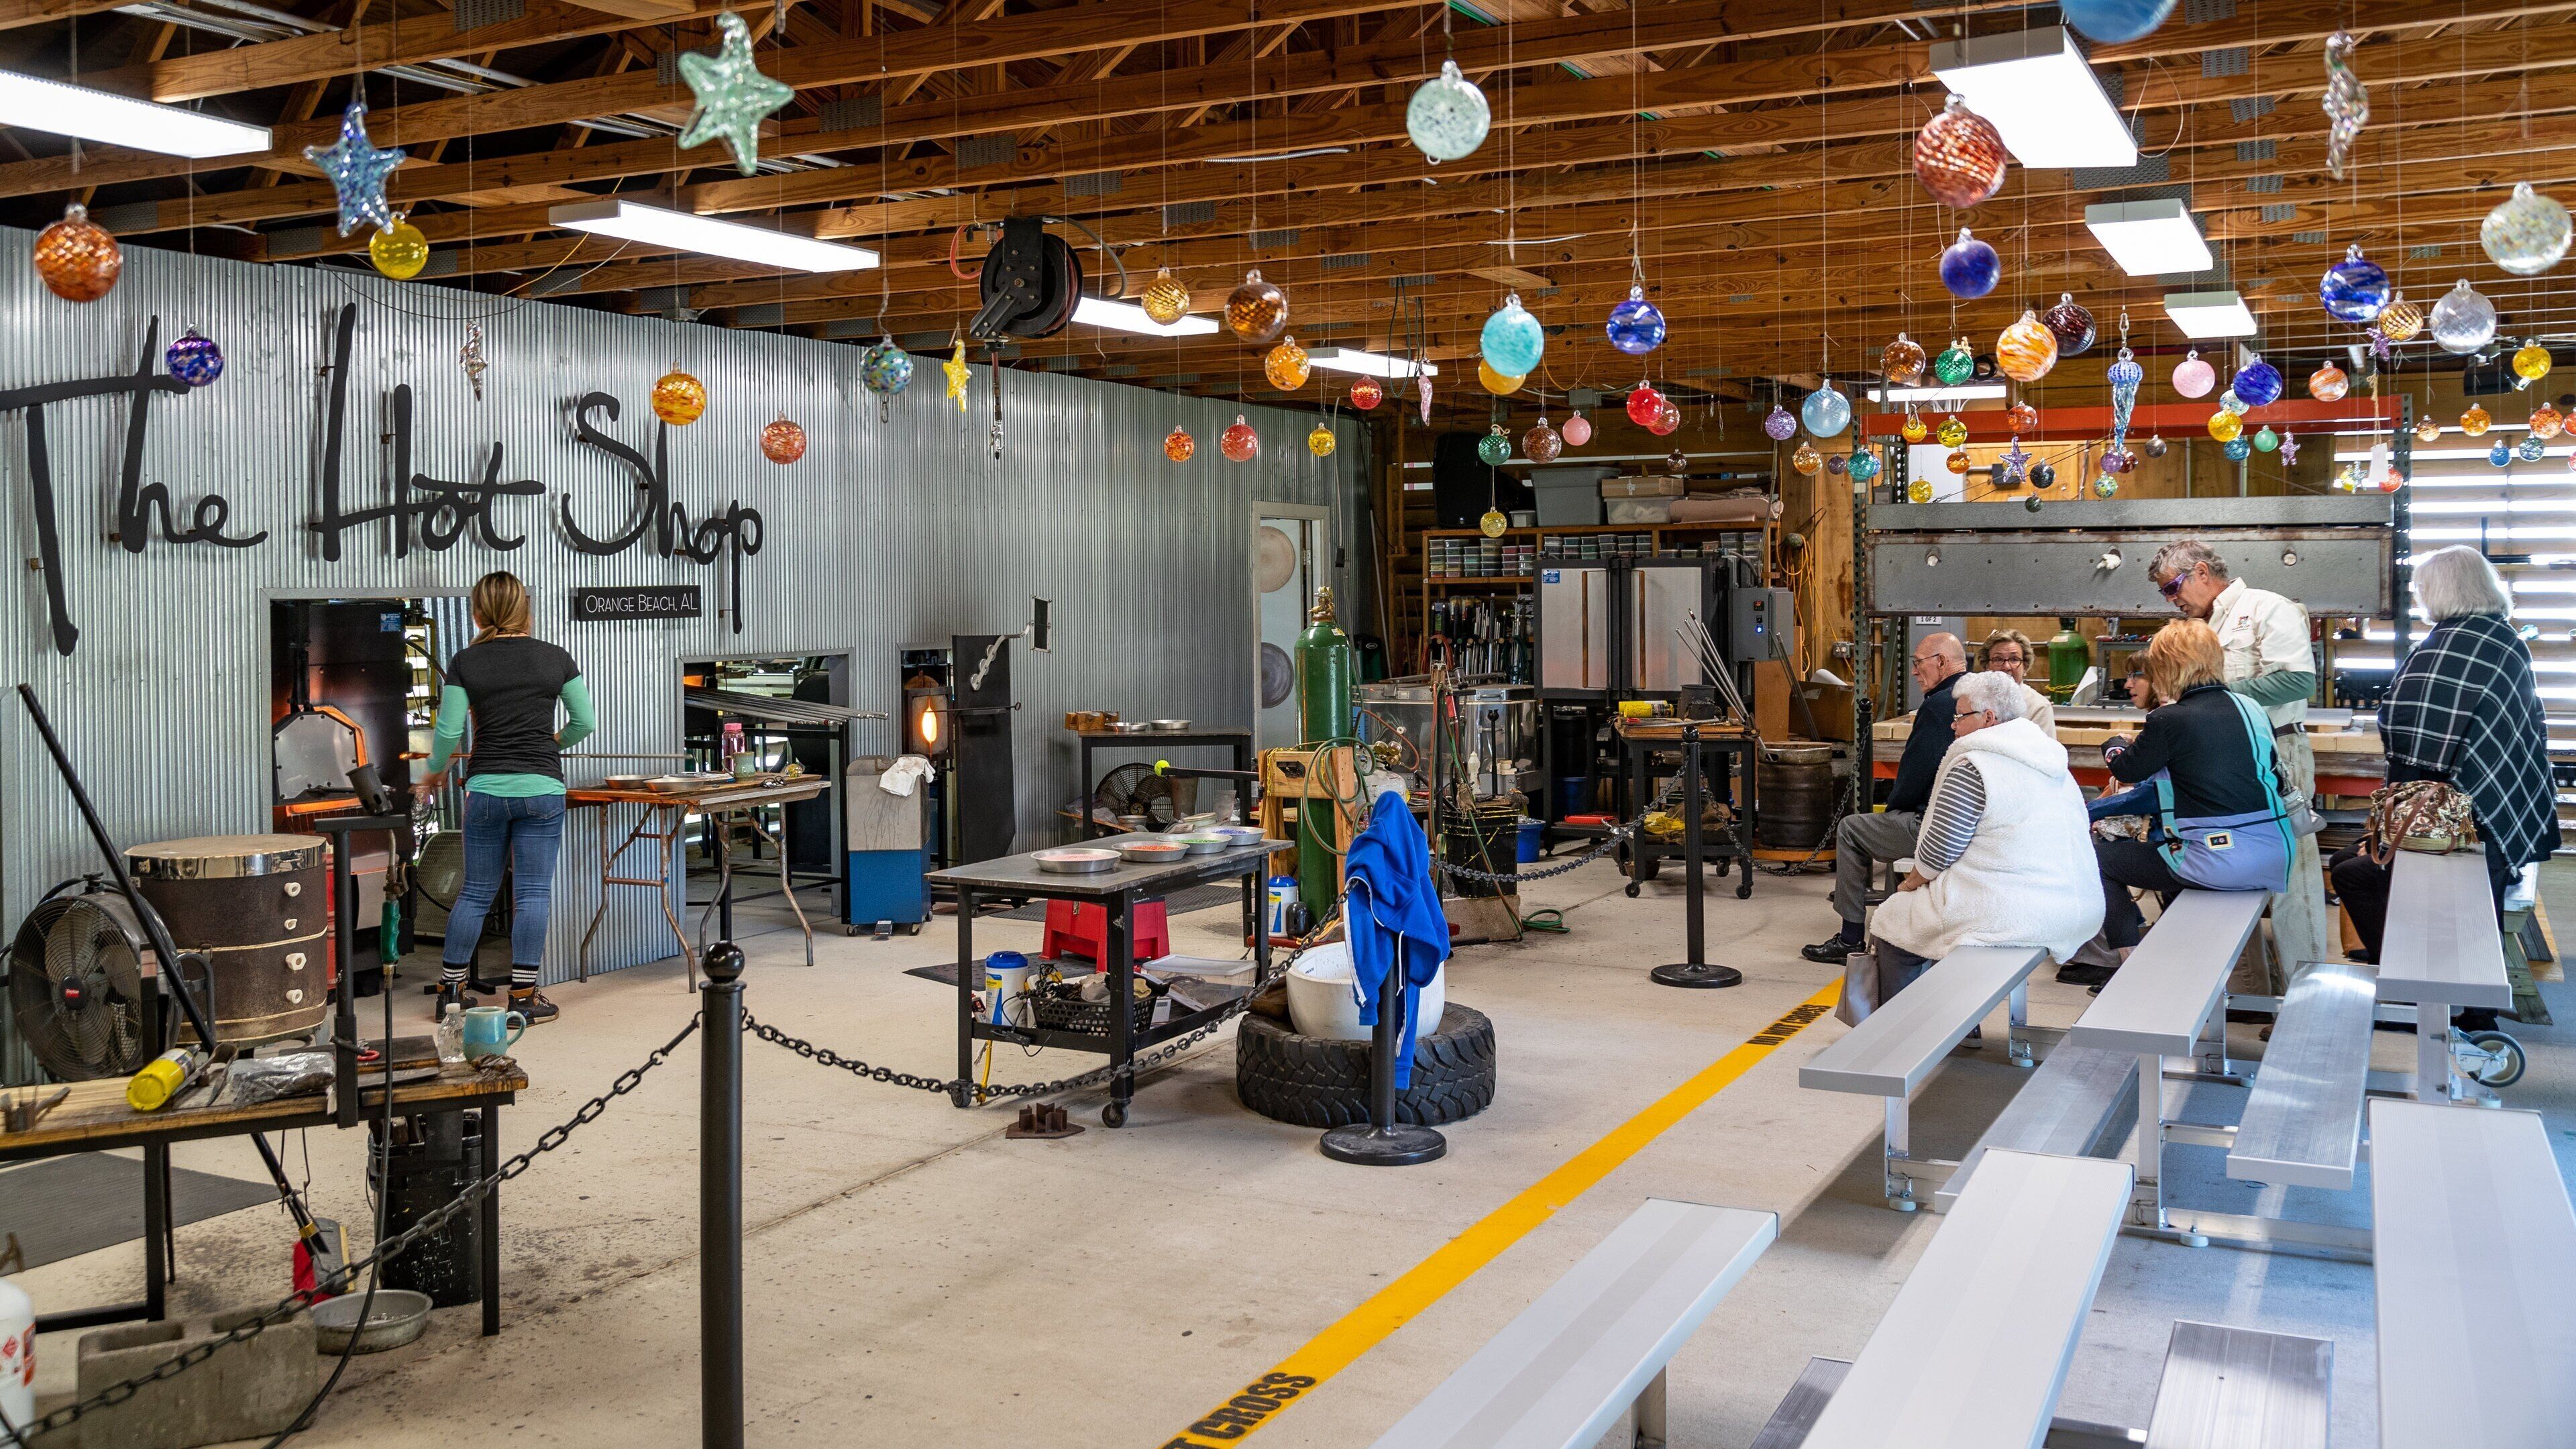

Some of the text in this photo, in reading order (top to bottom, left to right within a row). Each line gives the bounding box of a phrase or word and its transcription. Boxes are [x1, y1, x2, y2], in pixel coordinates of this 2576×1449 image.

[0, 303, 763, 657] The Hot Shop
[586, 592, 698, 613] ORANGE BEACH, AL
[1746, 1004, 1832, 1046] DO NOT CROSS
[1187, 1372, 1317, 1440] CROSS
